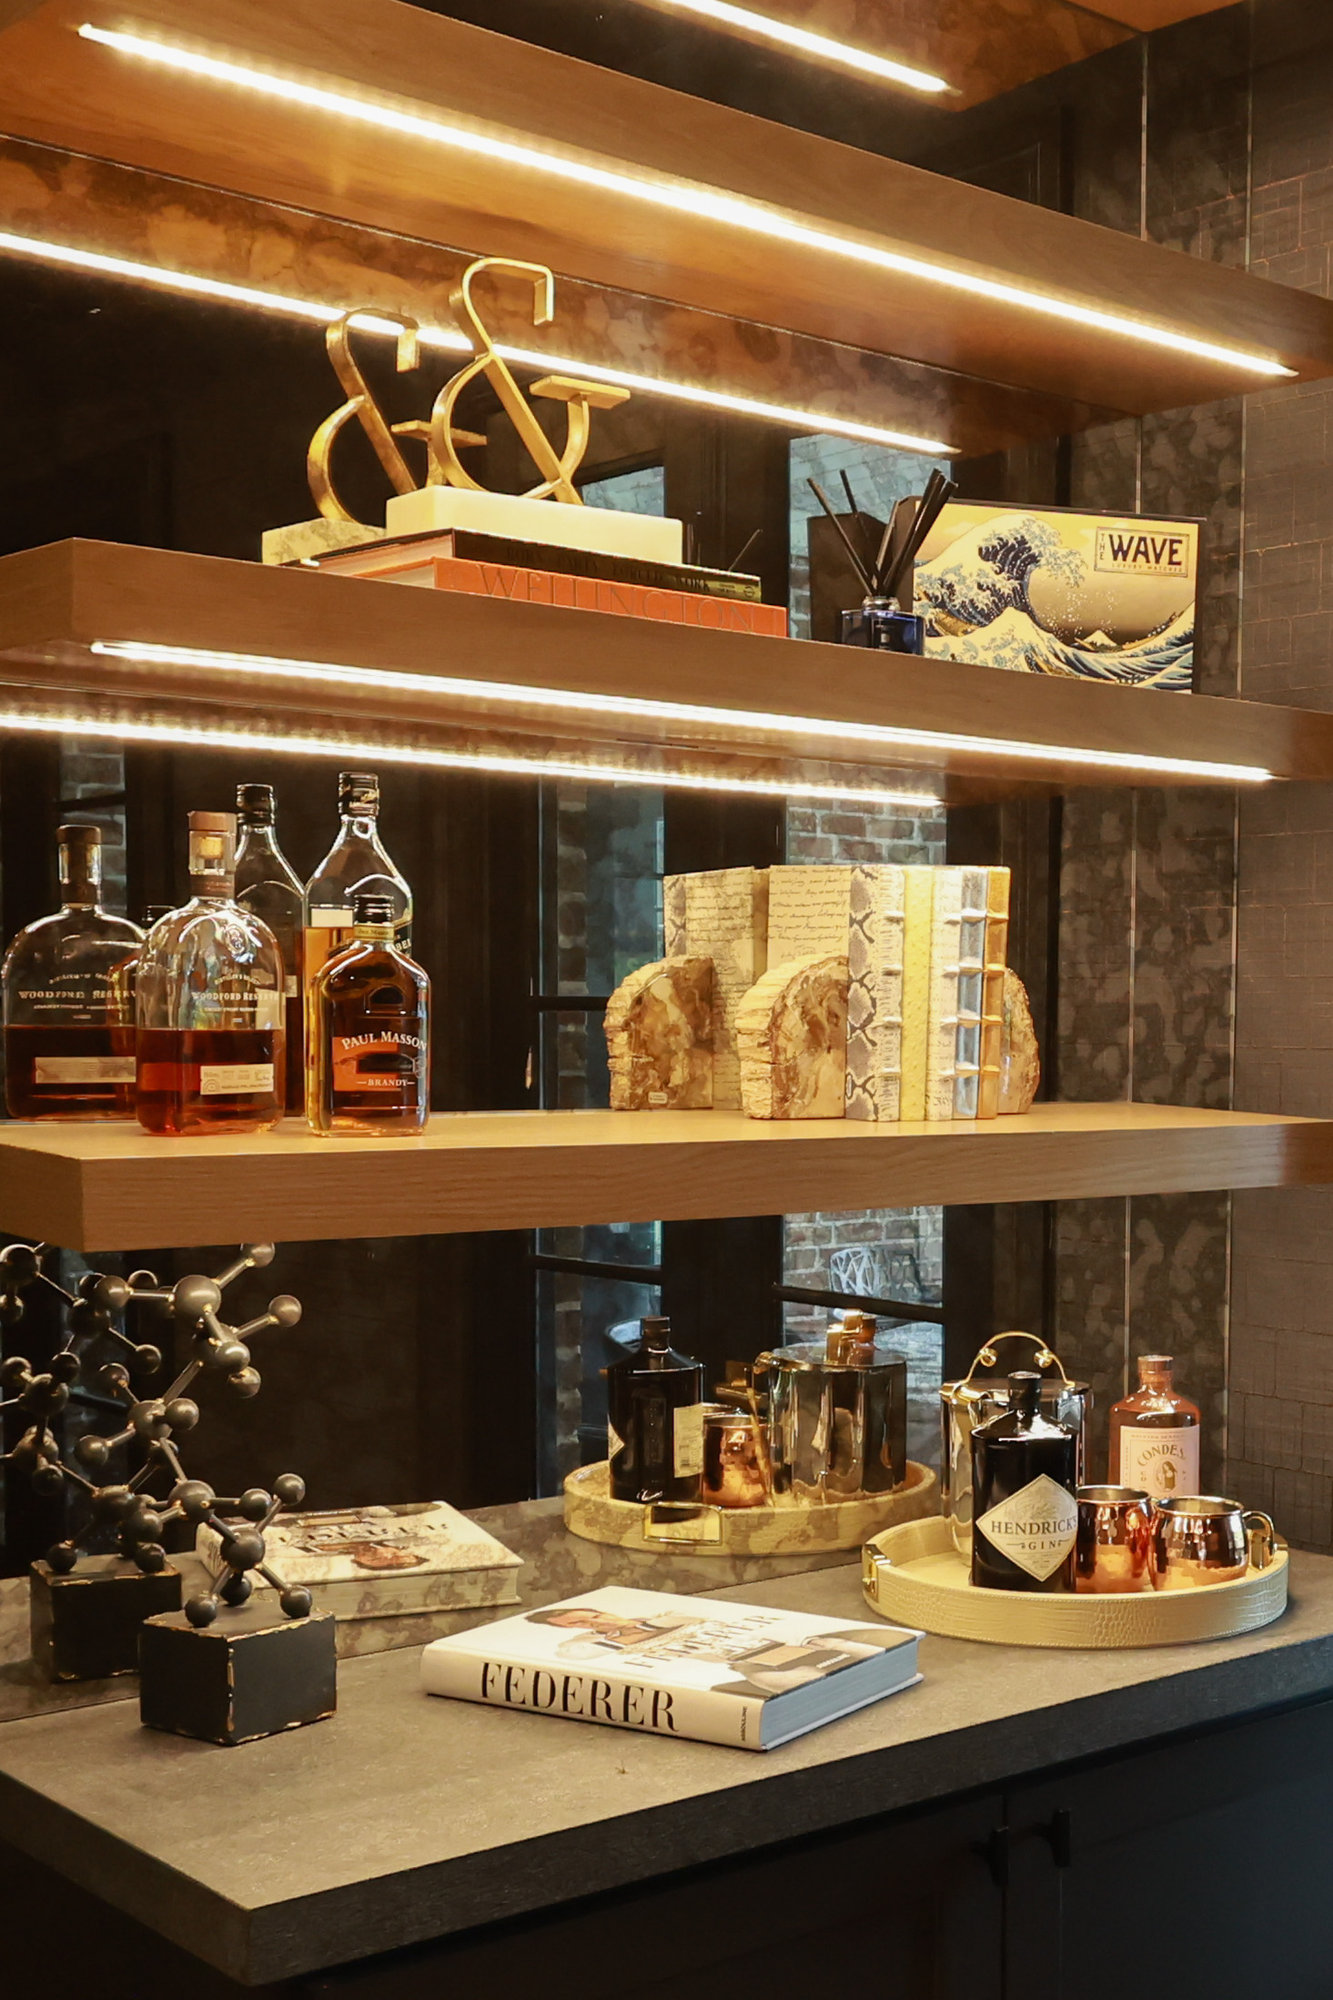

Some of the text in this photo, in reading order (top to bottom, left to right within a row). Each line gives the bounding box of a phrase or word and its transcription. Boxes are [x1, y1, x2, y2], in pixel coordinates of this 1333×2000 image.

[1108, 533, 1183, 566] WAVE
[475, 562, 756, 635] WELLINGTON
[191, 991, 242, 1001] WOODFORD
[341, 1030, 427, 1052] PAUL MASSON
[367, 1078, 408, 1087] BRANDY
[1028, 1540, 1057, 1550] GIN
[480, 1662, 679, 1733] FEDERER
